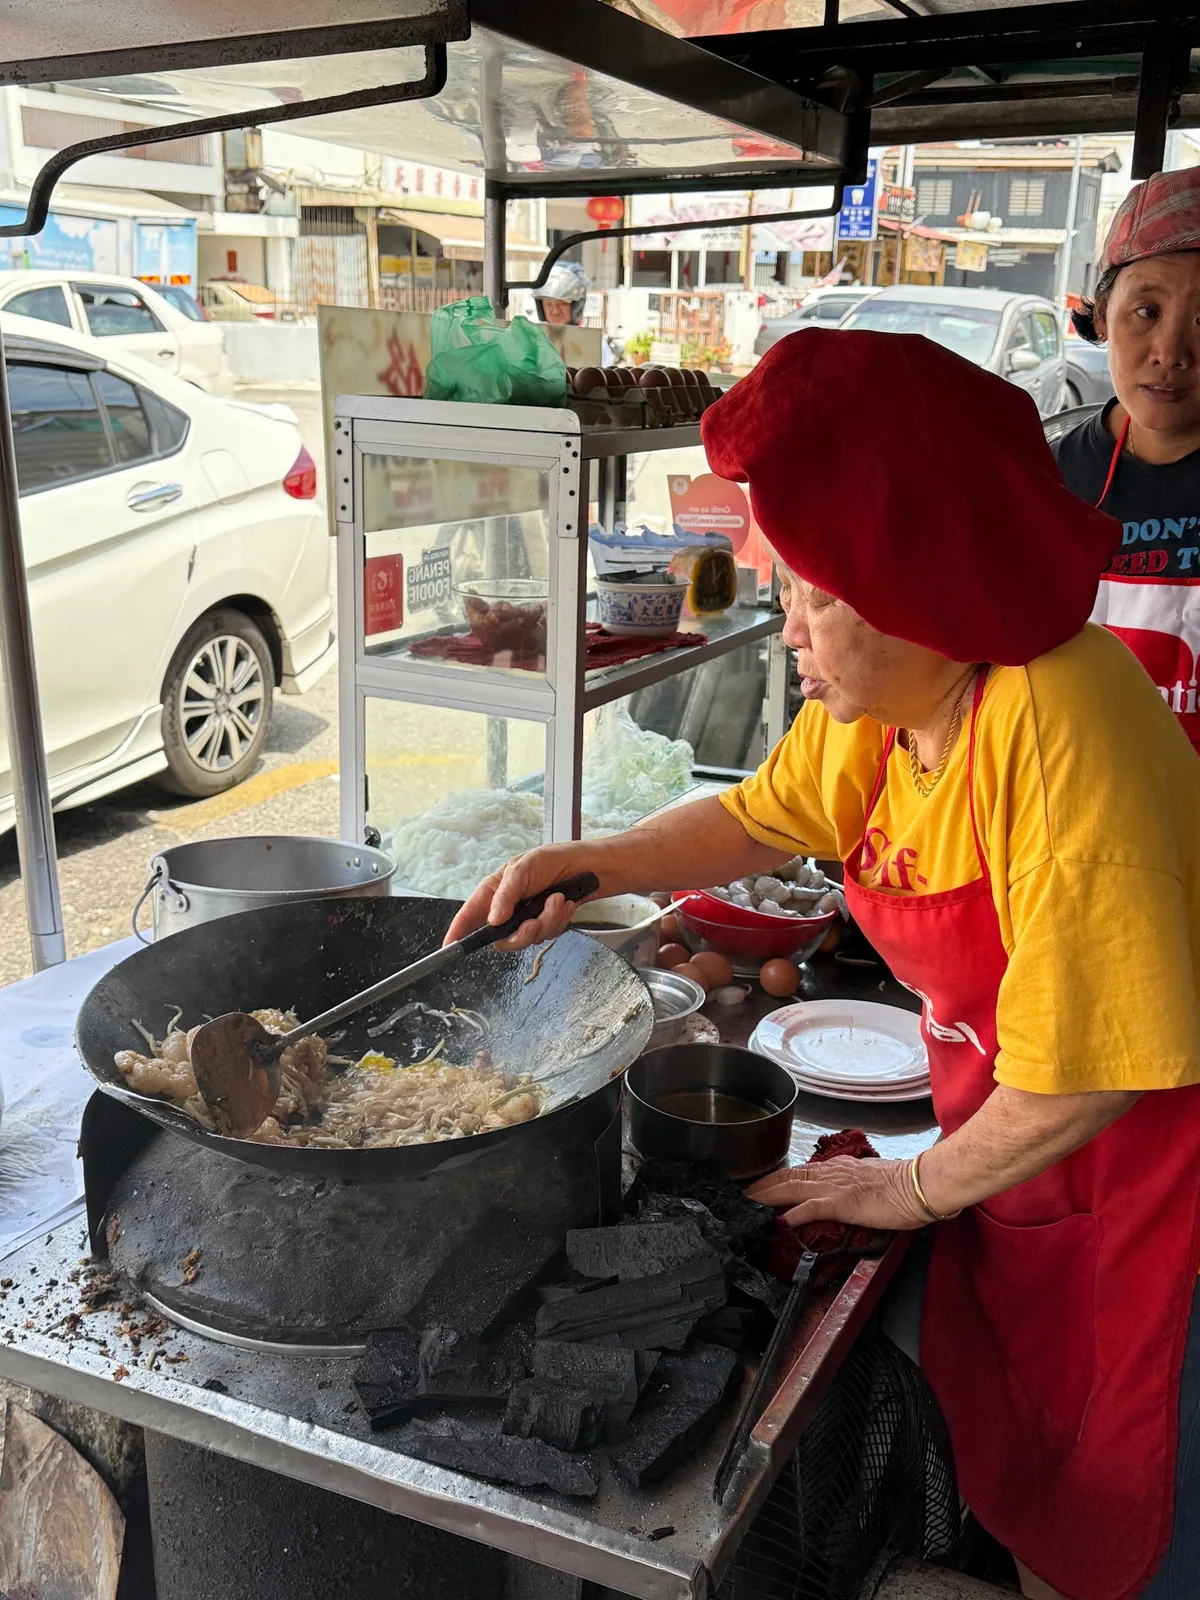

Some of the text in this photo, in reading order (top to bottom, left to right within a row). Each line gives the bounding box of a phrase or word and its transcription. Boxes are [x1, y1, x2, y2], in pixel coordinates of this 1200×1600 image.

[1121, 517, 1200, 546] DON'
[1105, 547, 1200, 574] EED T
